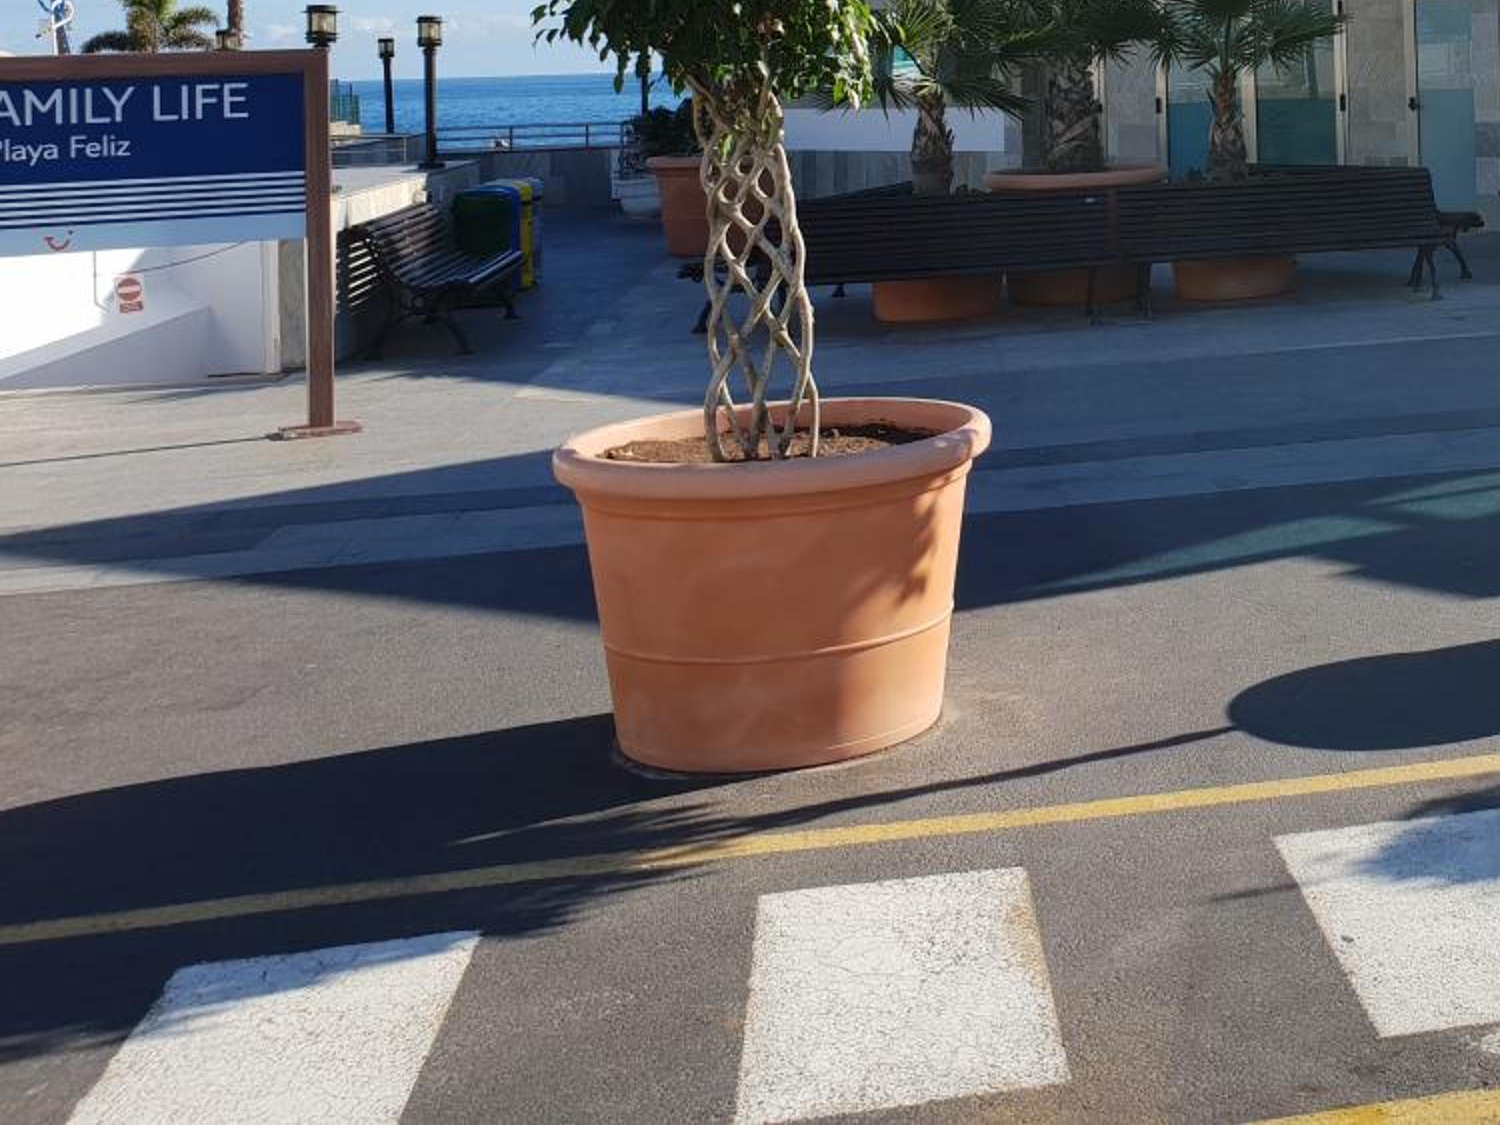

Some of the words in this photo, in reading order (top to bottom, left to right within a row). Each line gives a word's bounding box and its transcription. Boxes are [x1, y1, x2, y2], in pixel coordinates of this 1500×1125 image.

[152, 82, 249, 121] LIFE
[0, 138, 59, 166] laya
[69, 134, 131, 159] Feliz
